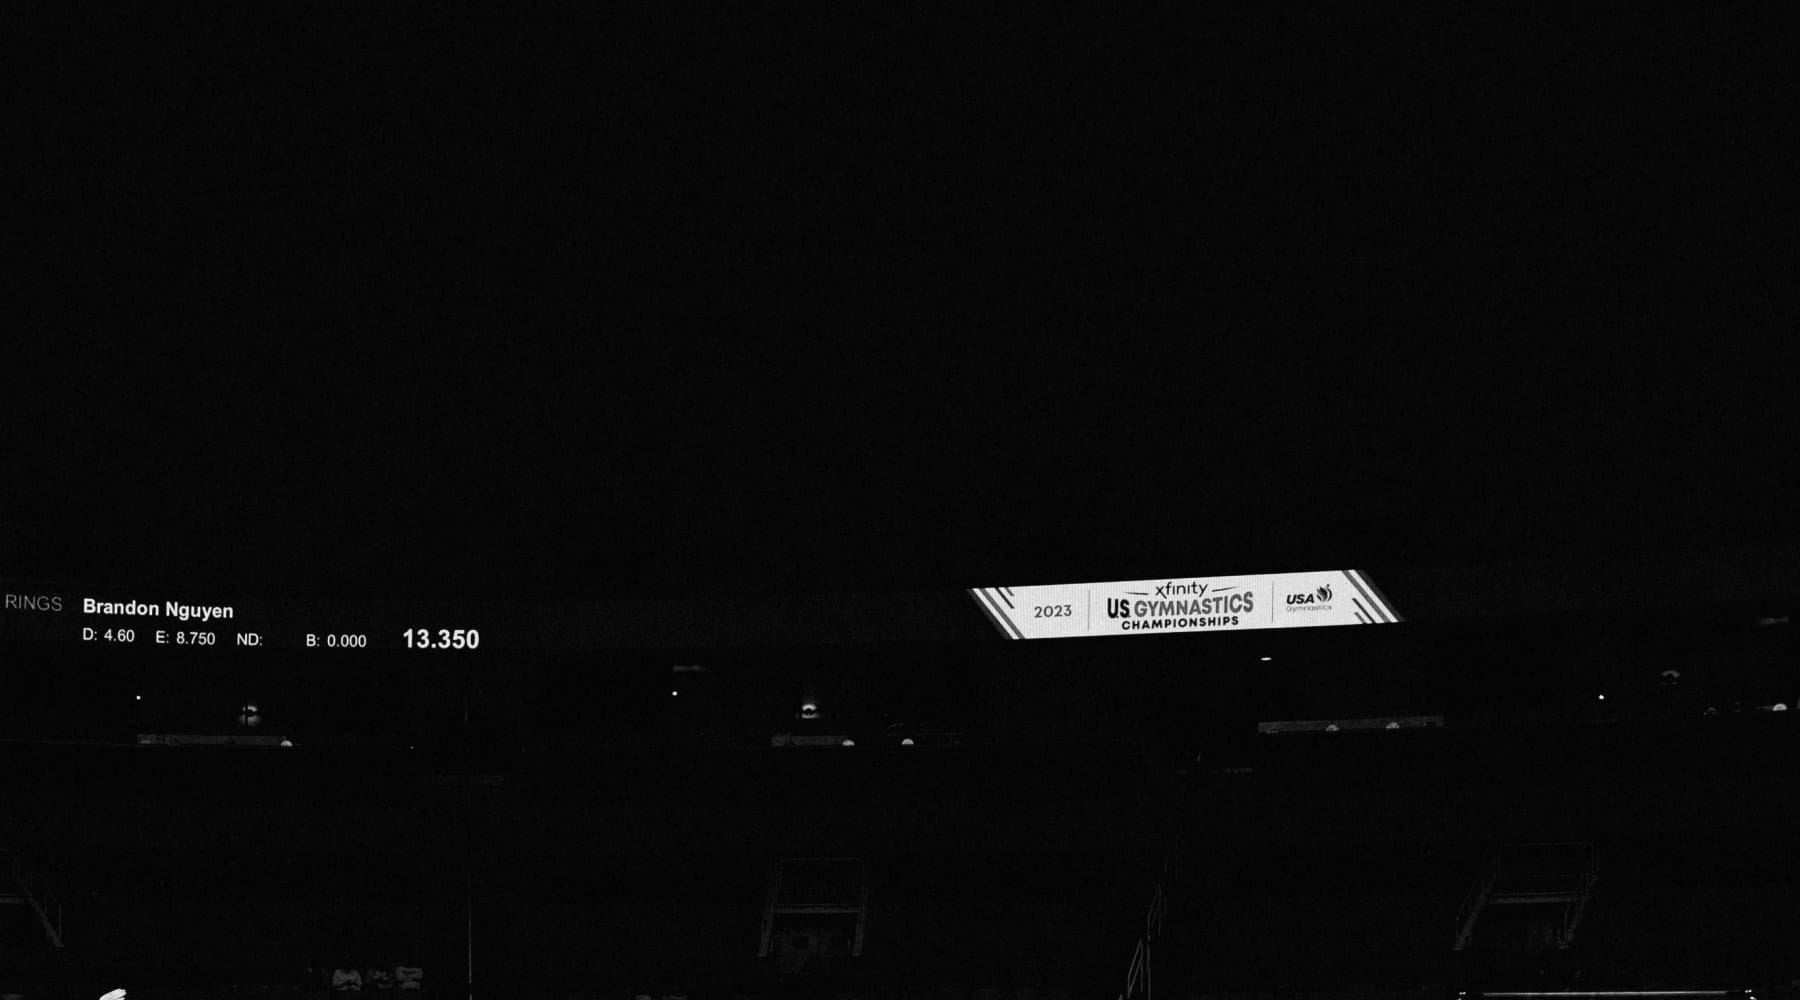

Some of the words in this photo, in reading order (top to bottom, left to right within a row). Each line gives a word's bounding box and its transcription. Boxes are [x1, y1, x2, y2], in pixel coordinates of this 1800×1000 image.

[1154, 581, 1209, 600] xfinity
[1286, 593, 1315, 605] USA
[5, 593, 63, 612] RINGS
[83, 597, 160, 617] Brandon
[165, 601, 234, 622] Nguyen
[1034, 604, 1073, 619] 2023
[1107, 597, 1131, 619] US
[1133, 591, 1255, 618] GYMNASTICS
[1121, 615, 1240, 631] CHAMPIONSHIPS
[82, 627, 98, 641] D:
[103, 628, 135, 643] 4.60
[155, 630, 169, 644] E:
[176, 631, 216, 646] 8.750
[236, 632, 263, 646] ND:
[306, 633, 320, 647] B:
[327, 633, 367, 648] 0.000
[403, 628, 480, 650] 13.350
